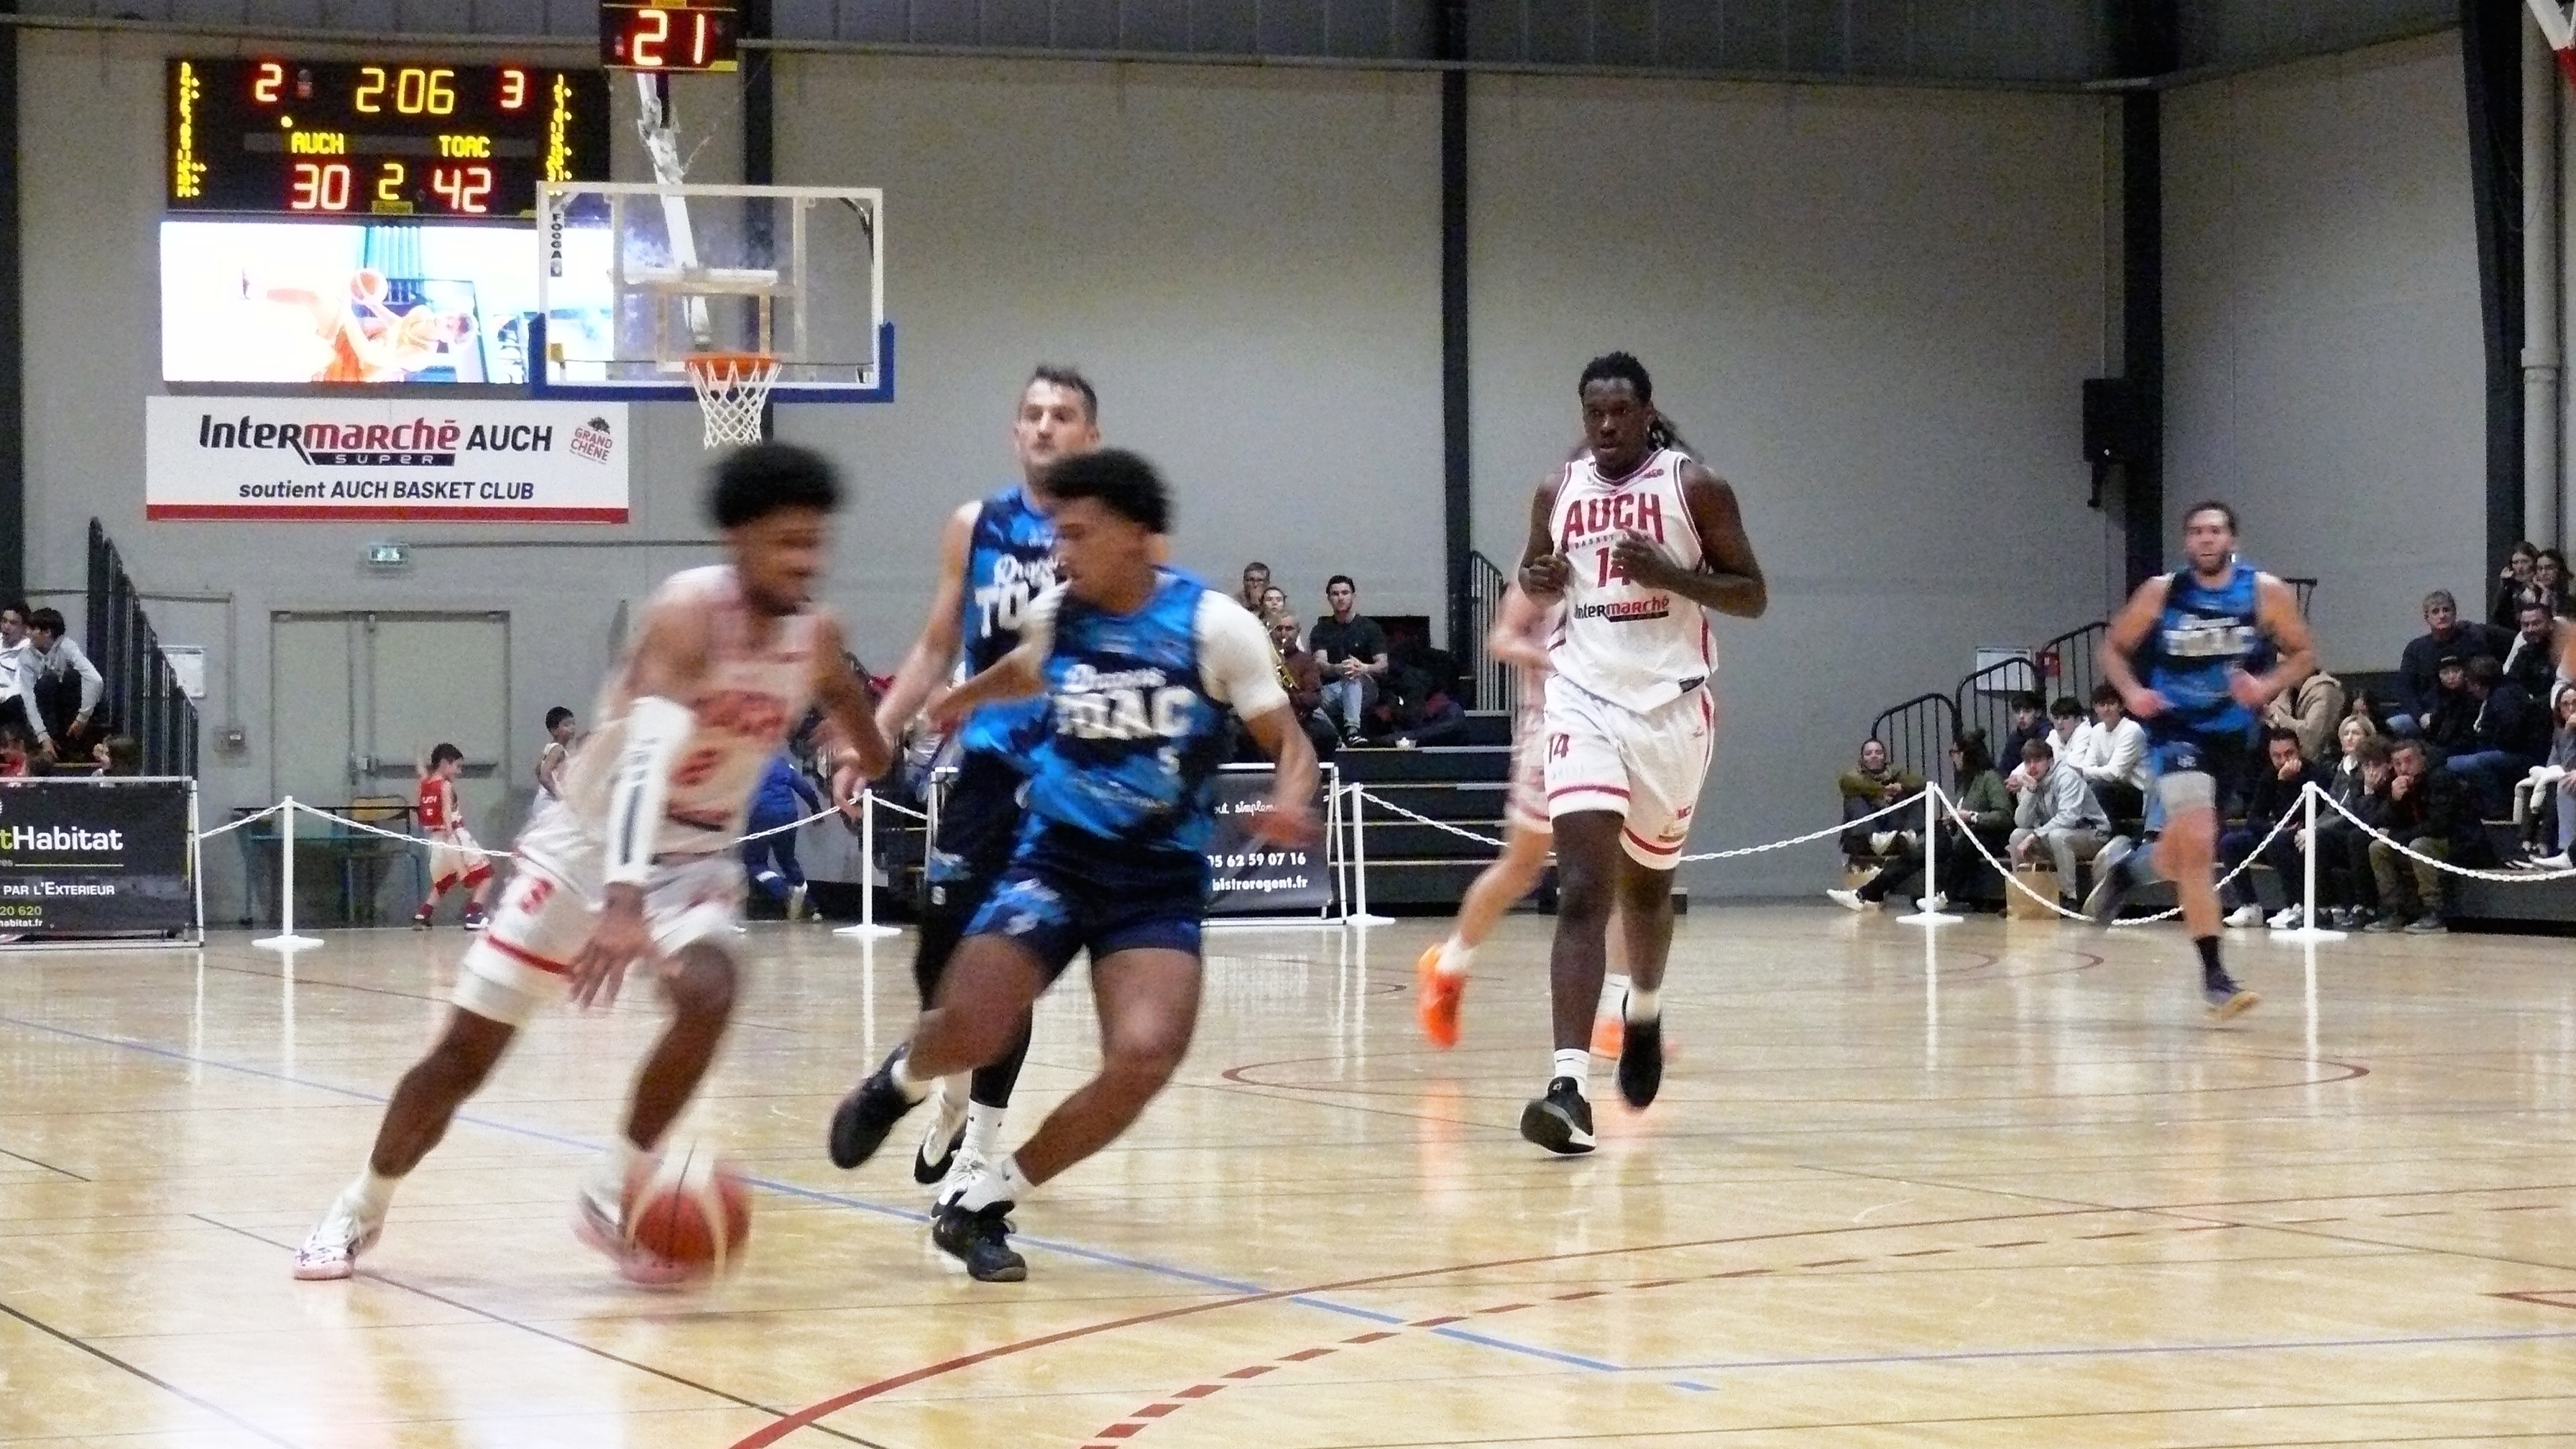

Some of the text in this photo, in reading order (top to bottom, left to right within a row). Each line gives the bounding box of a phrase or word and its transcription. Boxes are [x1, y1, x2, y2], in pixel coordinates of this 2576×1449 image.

[633, 9, 705, 65] 21
[255, 63, 282, 102] 2
[500, 70, 525, 109] 3
[291, 132, 344, 155] AUCH
[438, 134, 491, 157] TOAC
[292, 162, 350, 210] 30
[379, 162, 404, 201] 2
[433, 167, 492, 213] 42
[466, 425, 553, 451] AUCH
[574, 428, 612, 448] GRAND
[239, 480, 534, 500] soutient AUCH BASKET CLUB
[1560, 492, 1665, 553] AUCH
[1549, 733, 1570, 763] 14
[0, 826, 124, 850] tHabitat
[1226, 855, 1244, 868] 62
[1248, 853, 1264, 866] 59
[1268, 852, 1285, 865] 07
[1290, 852, 1306, 865] 16
[4, 885, 29, 896] PAR
[18, 906, 42, 916] 620
